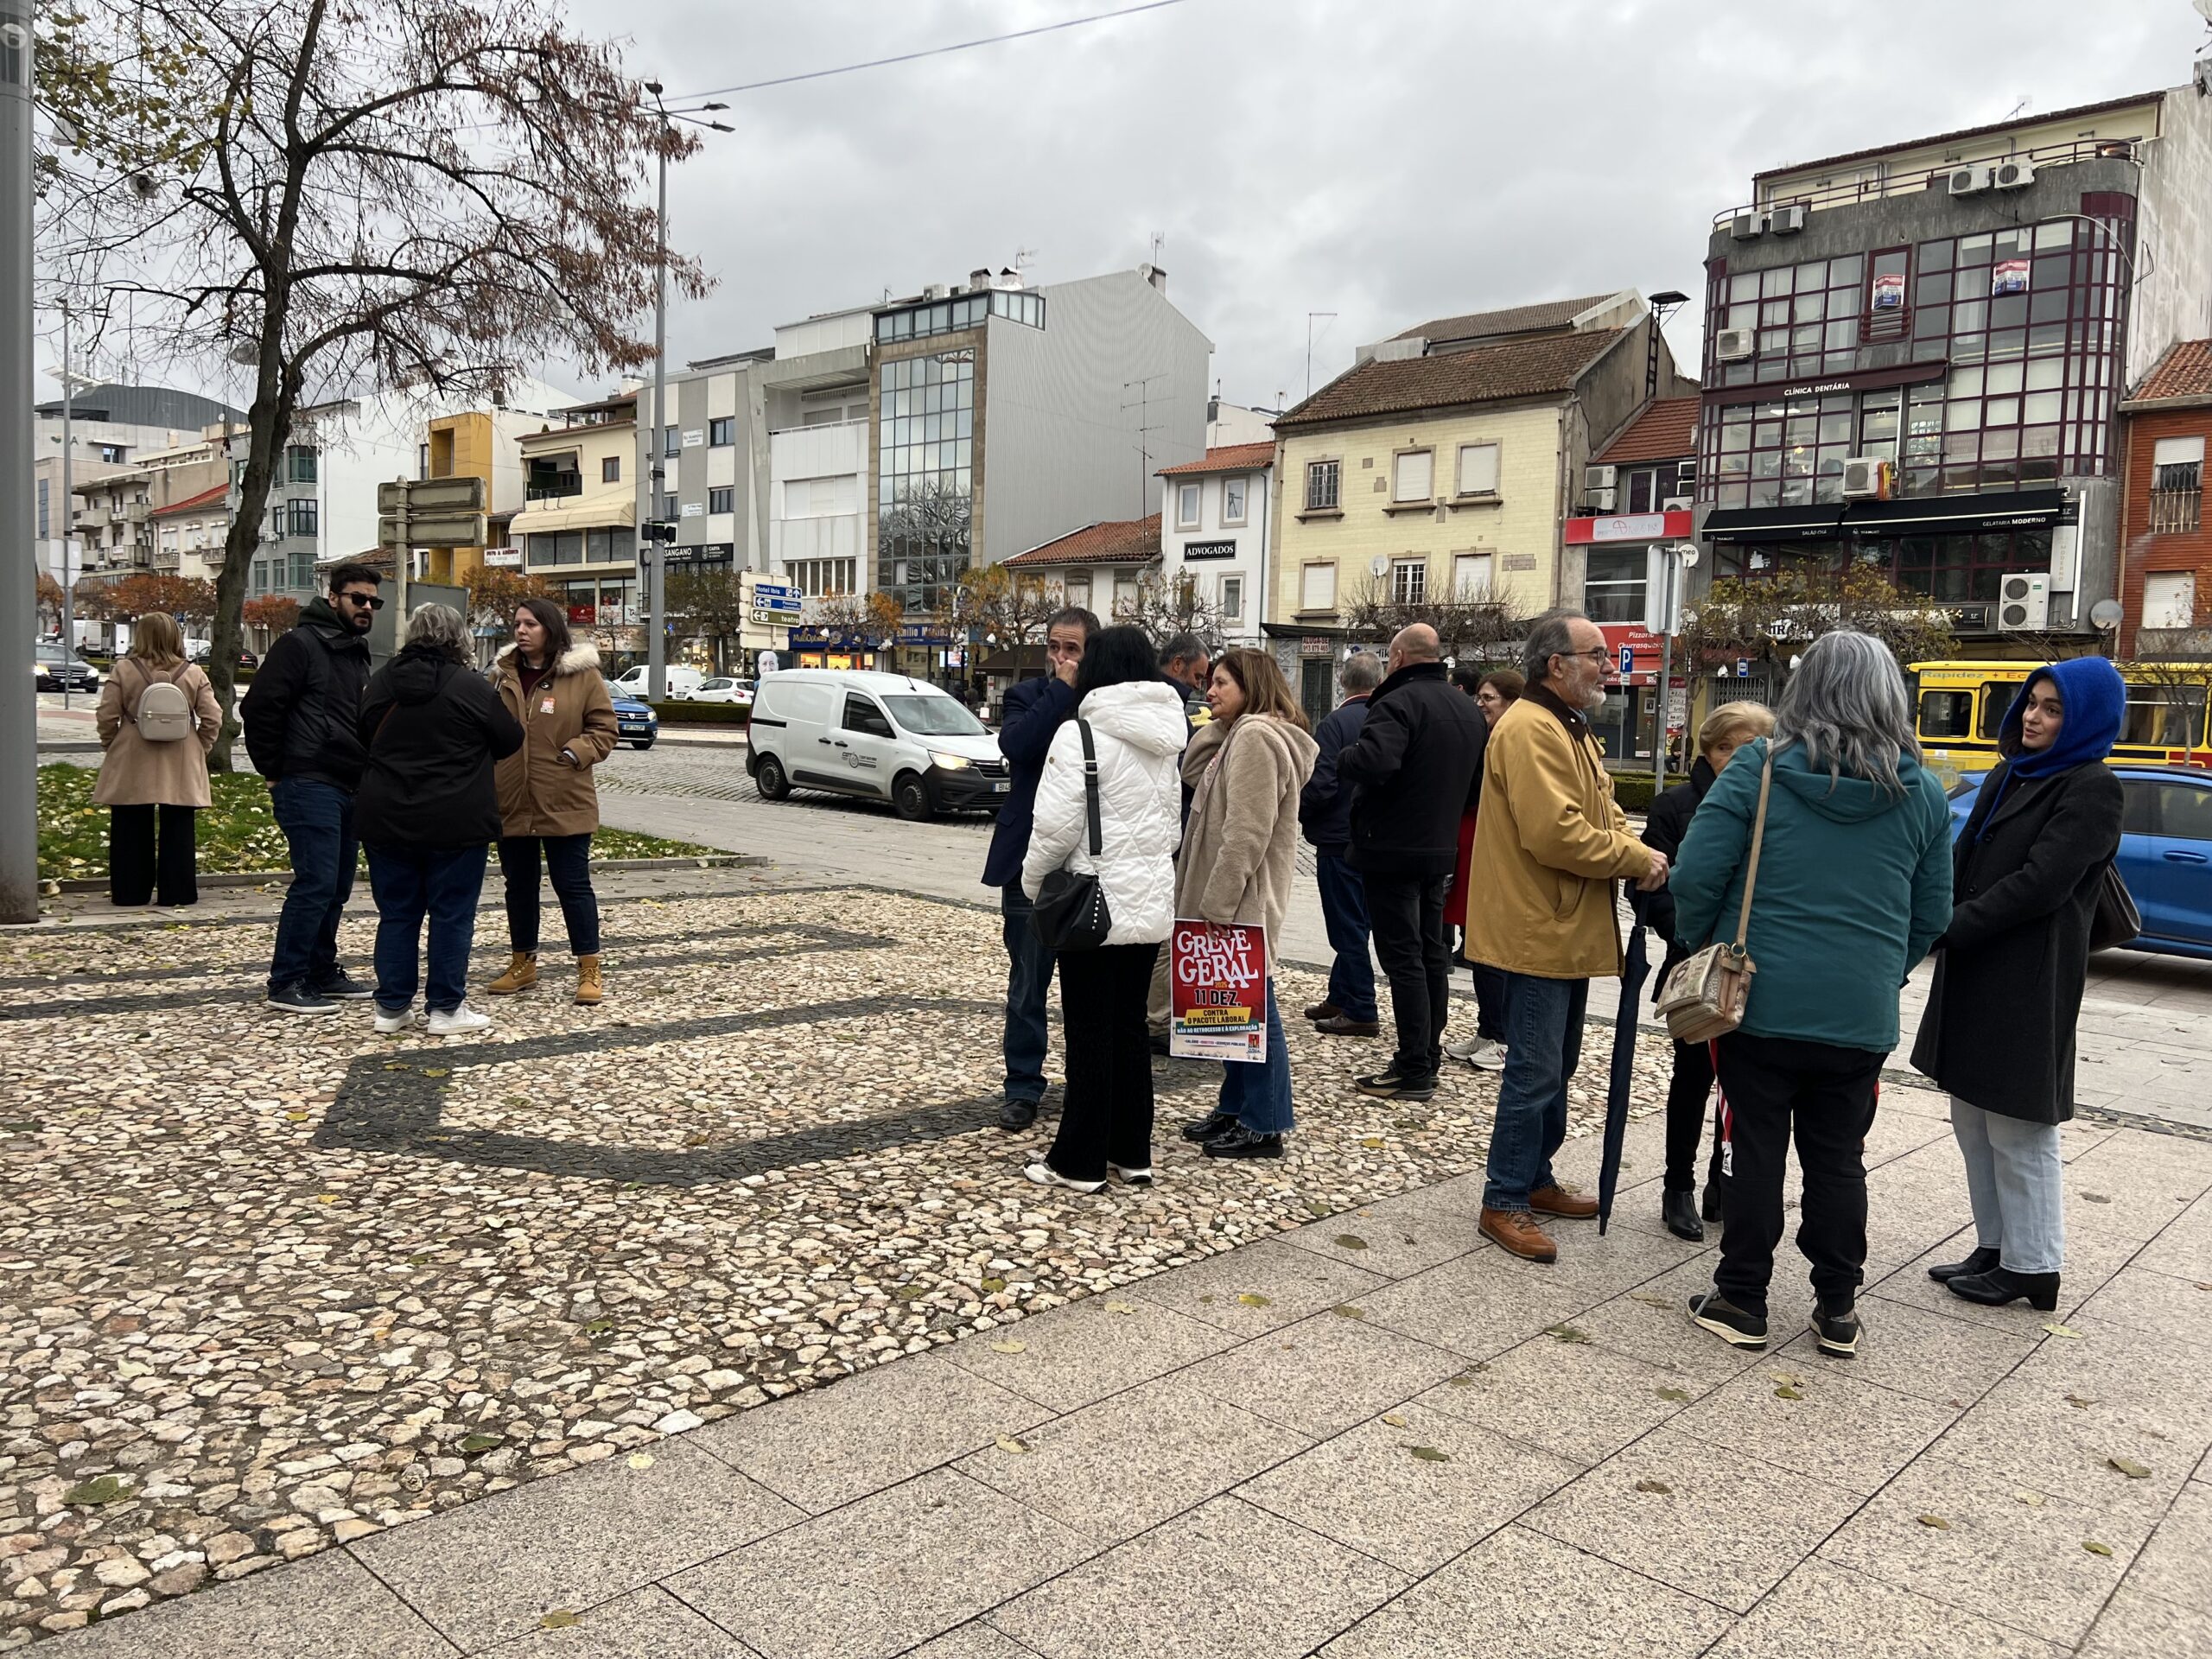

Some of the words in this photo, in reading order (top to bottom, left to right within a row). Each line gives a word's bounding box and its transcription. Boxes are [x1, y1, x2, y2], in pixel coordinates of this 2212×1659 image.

[1784, 387, 1812, 396] CLÍNICA
[1815, 382, 1850, 392] DENTÁRIA
[2012, 517, 2046, 525] MODERNO
[1186, 545, 1234, 556] ADVOGADOS
[1623, 649, 1630, 670] P
[1177, 929, 1252, 961] GREVE
[1178, 952, 1259, 988] GERAL
[1194, 988, 1207, 1005] 11
[1210, 989, 1243, 1007] DEZ.
[1217, 1015, 1246, 1024] LABORAL
